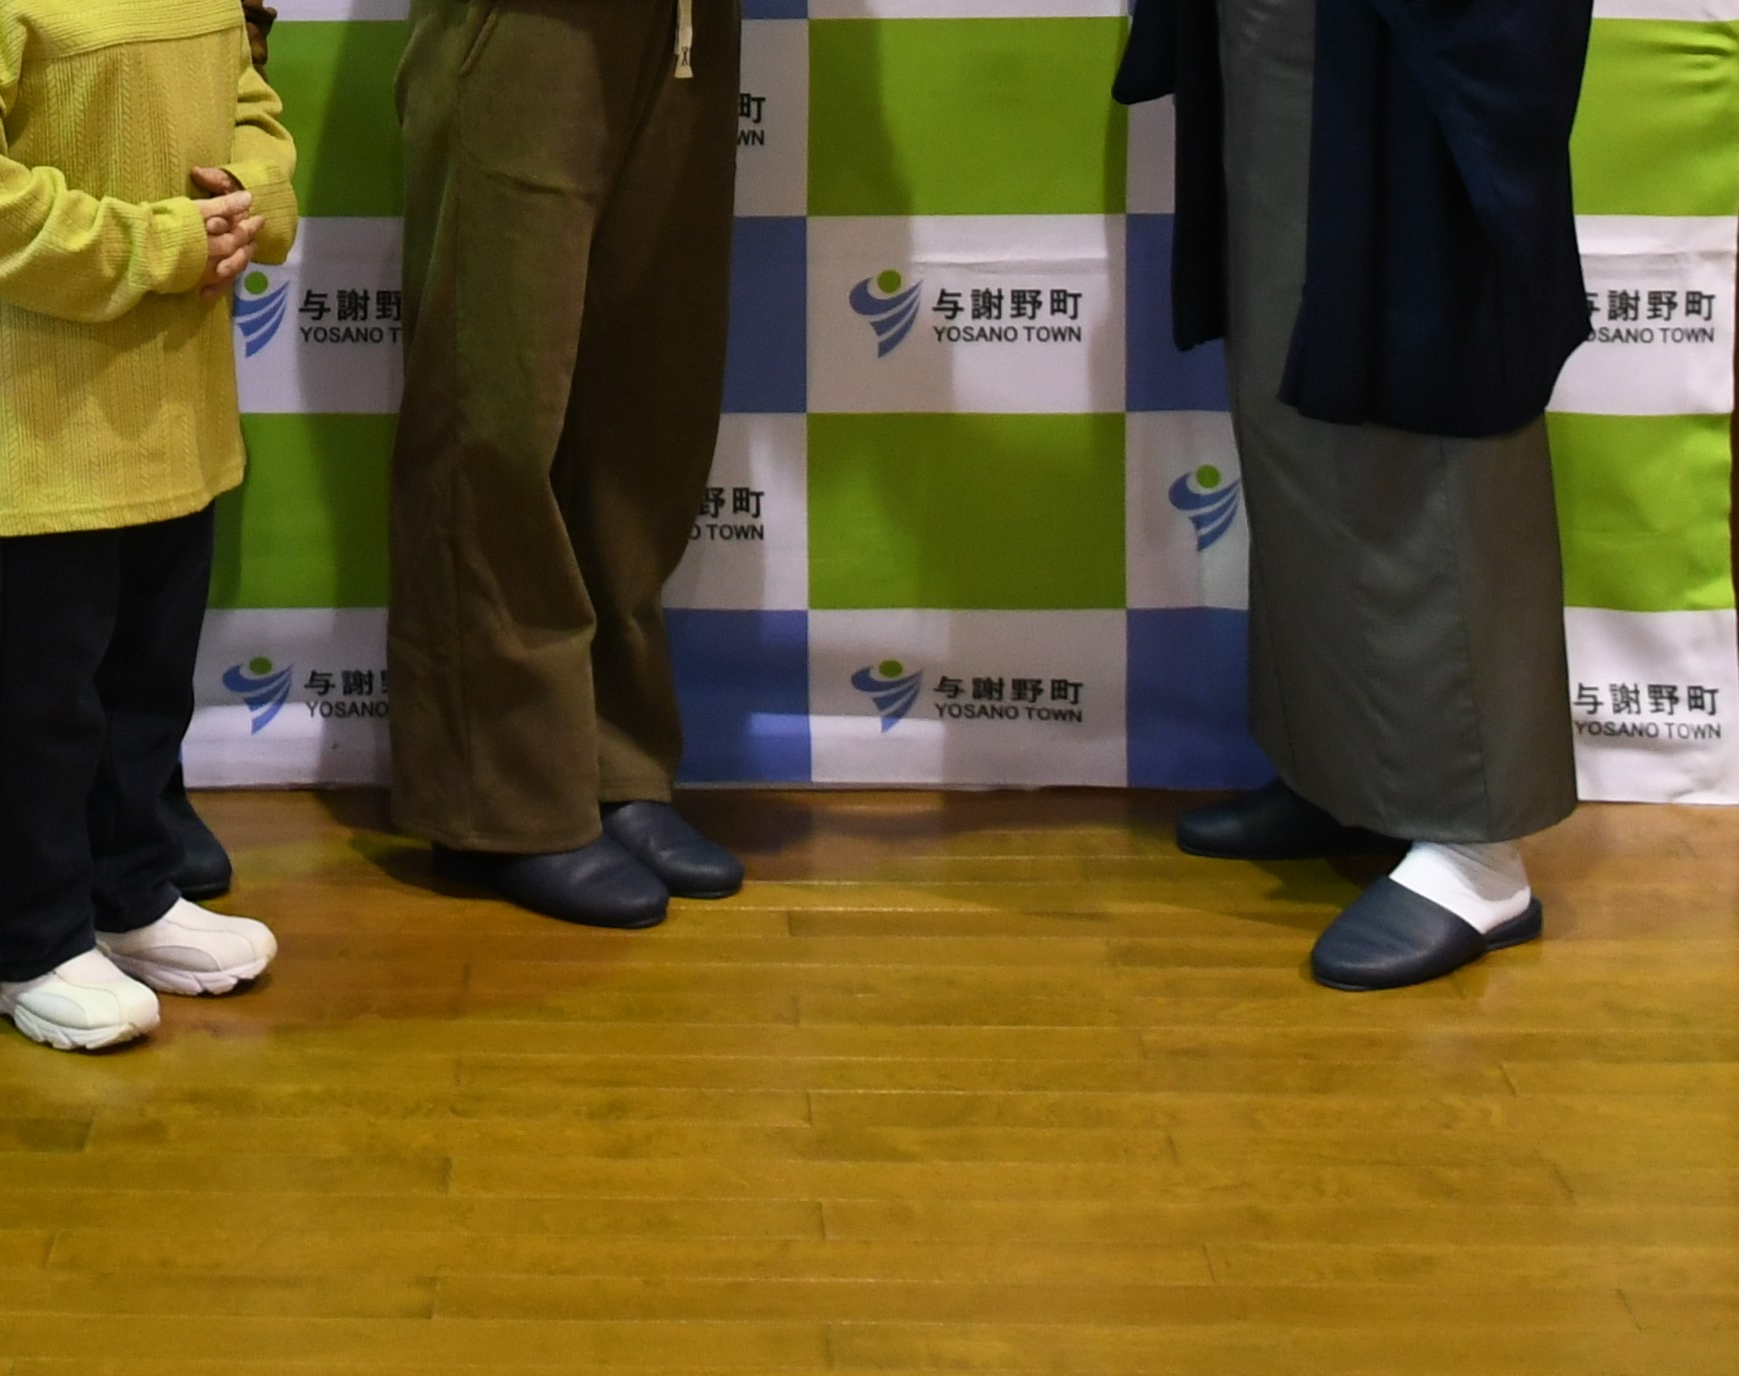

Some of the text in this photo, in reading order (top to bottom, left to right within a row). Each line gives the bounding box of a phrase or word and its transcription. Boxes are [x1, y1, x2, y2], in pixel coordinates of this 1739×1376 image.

[931, 287, 1083, 321] 与謝野町
[299, 325, 384, 344] YOSANO
[932, 325, 1082, 343] YOSANO TOWN
[1660, 324, 1715, 344] TOWN
[705, 523, 765, 541] TOWN
[303, 669, 389, 702] 与謝
[932, 674, 1084, 707] 与謝野町
[1573, 682, 1720, 717] 与謝野町
[933, 702, 1083, 724] YOSANO TOWN
[1574, 720, 1722, 739] YOSANO TOWN
